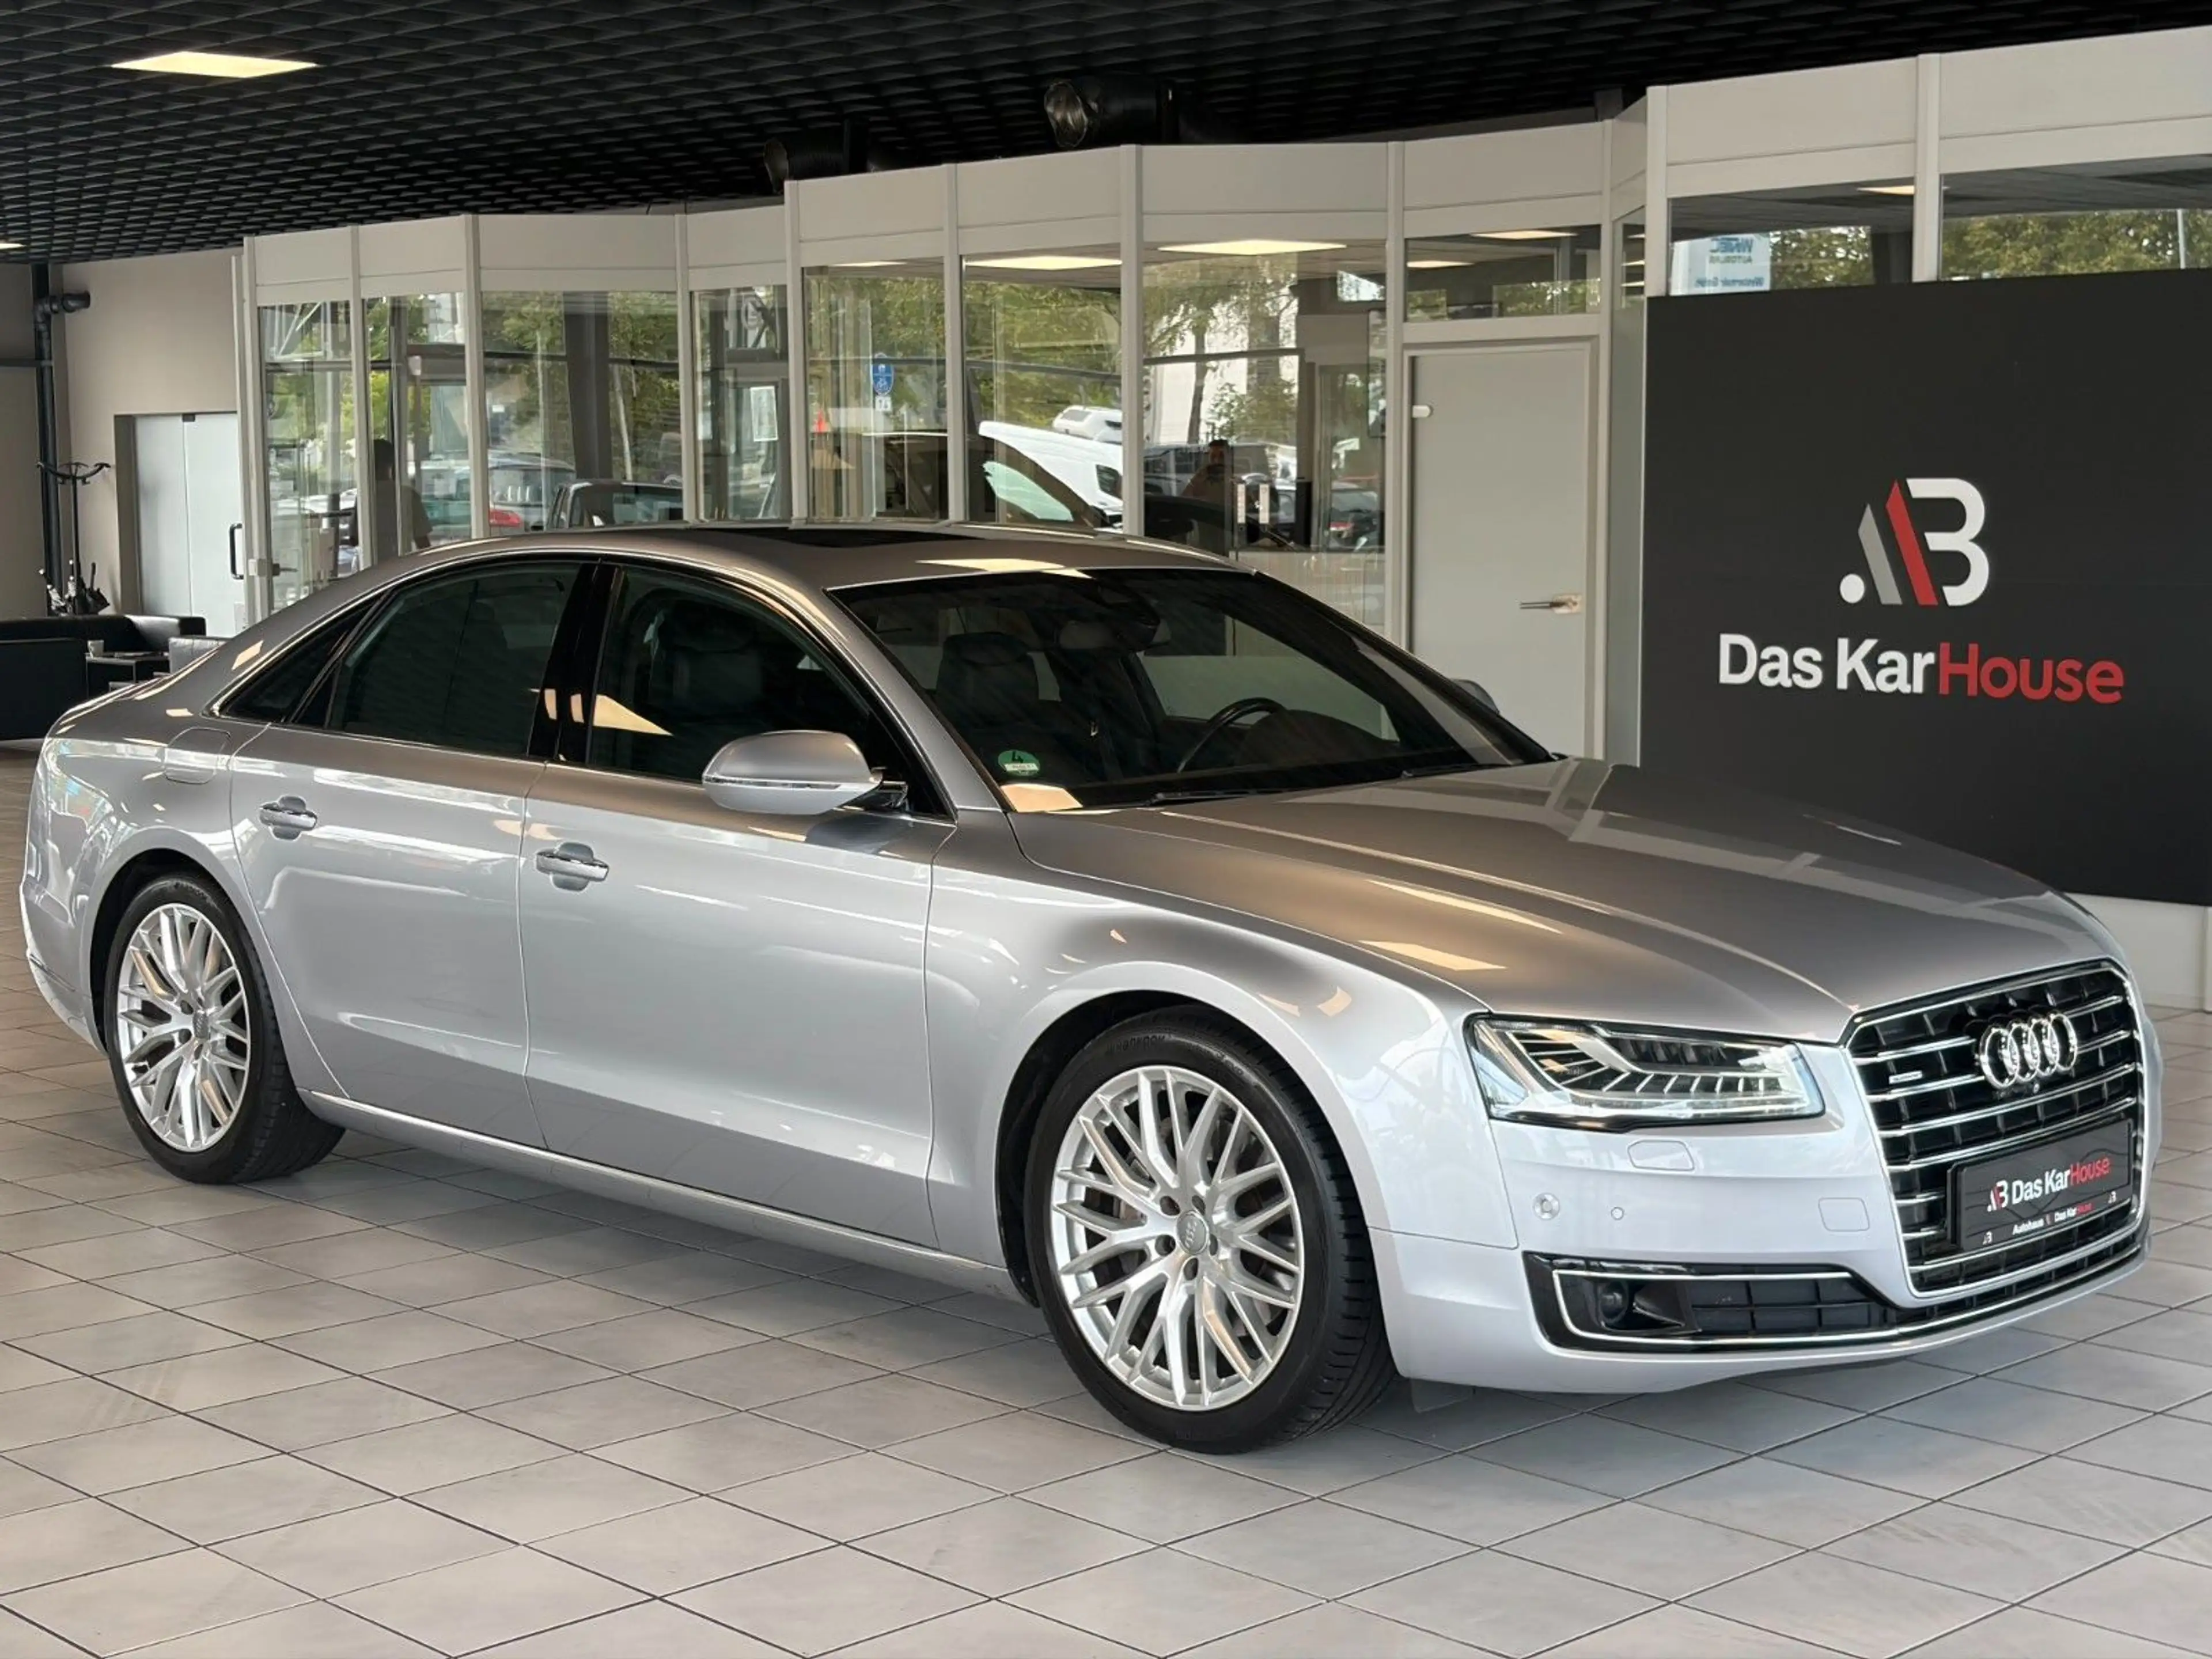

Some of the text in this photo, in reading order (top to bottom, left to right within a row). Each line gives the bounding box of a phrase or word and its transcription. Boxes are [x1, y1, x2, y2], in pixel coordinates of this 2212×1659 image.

[1719, 633, 2124, 704] Das KarHouse
[1012, 751, 1024, 763] 4
[2012, 1178, 2043, 1205] Das
[2044, 1157, 2111, 1195] KarHouse
